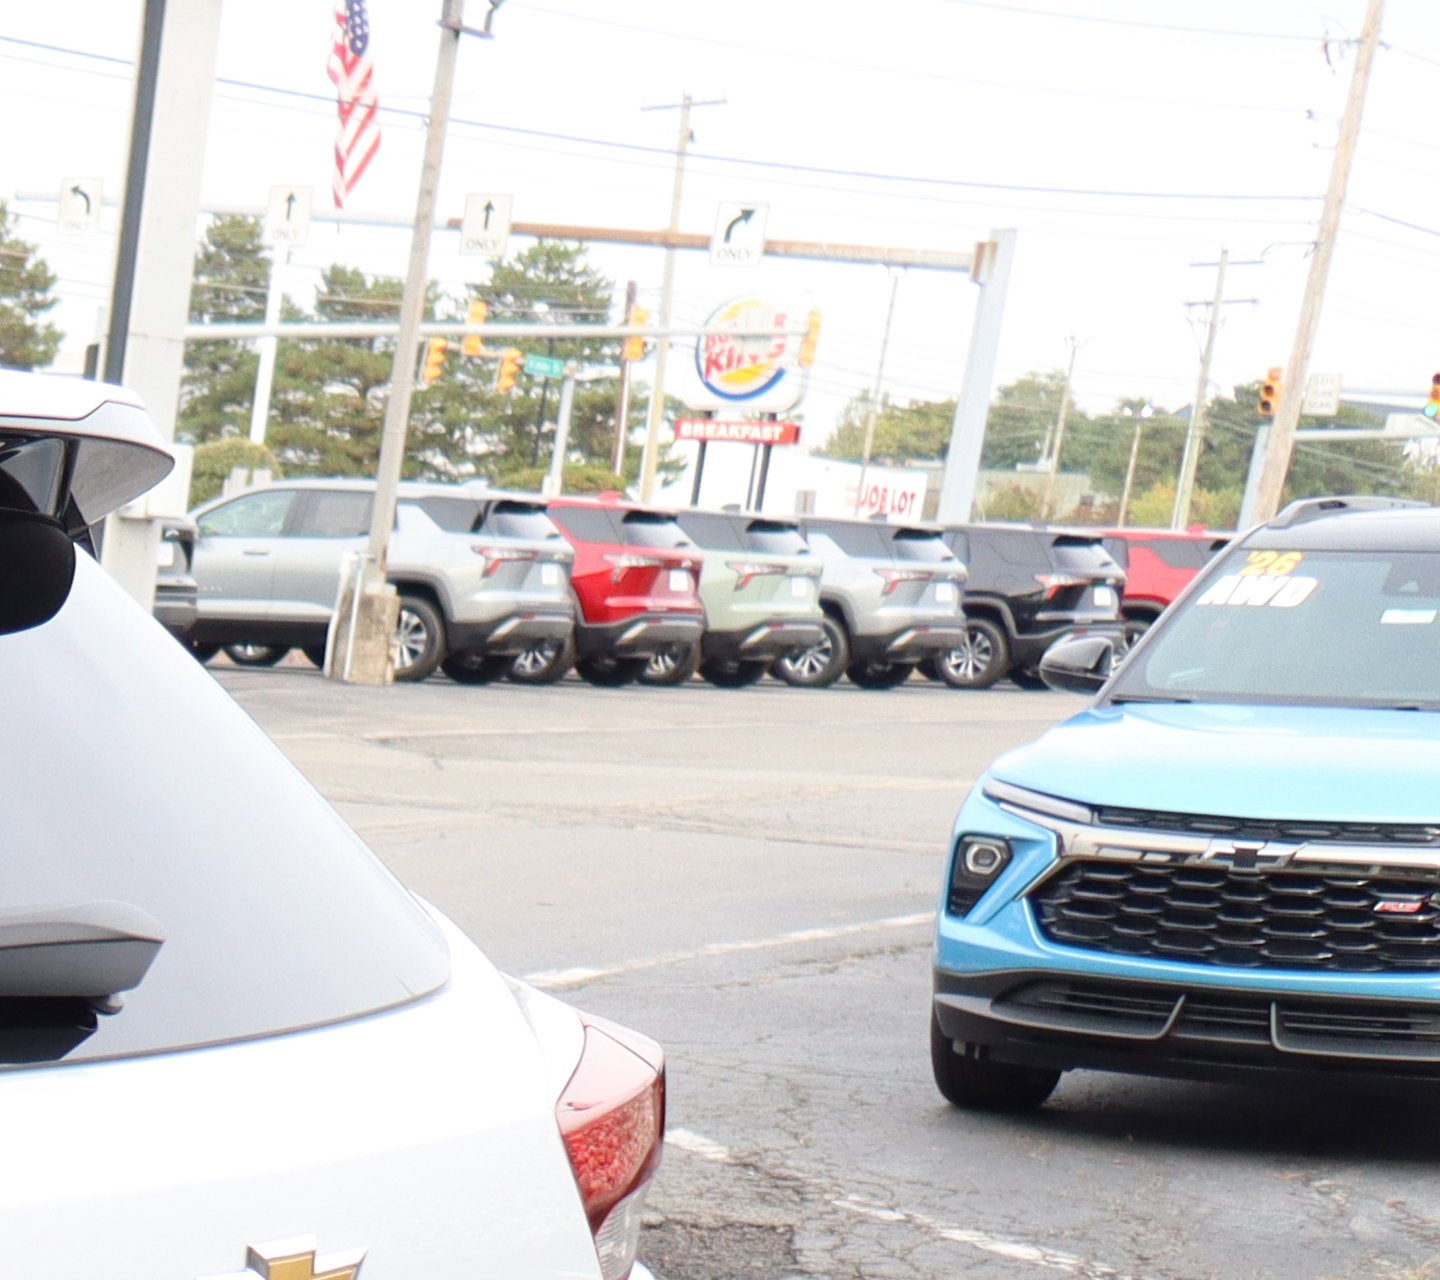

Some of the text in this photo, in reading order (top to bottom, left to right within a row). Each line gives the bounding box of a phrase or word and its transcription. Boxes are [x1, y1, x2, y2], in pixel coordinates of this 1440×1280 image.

[466, 239, 500, 251] ONLY
[717, 247, 753, 261] ONLY
[680, 422, 783, 441] BREAKFAST
[859, 484, 888, 513] JOB
[890, 488, 916, 517] LOT
[1196, 574, 1320, 608] AWD
